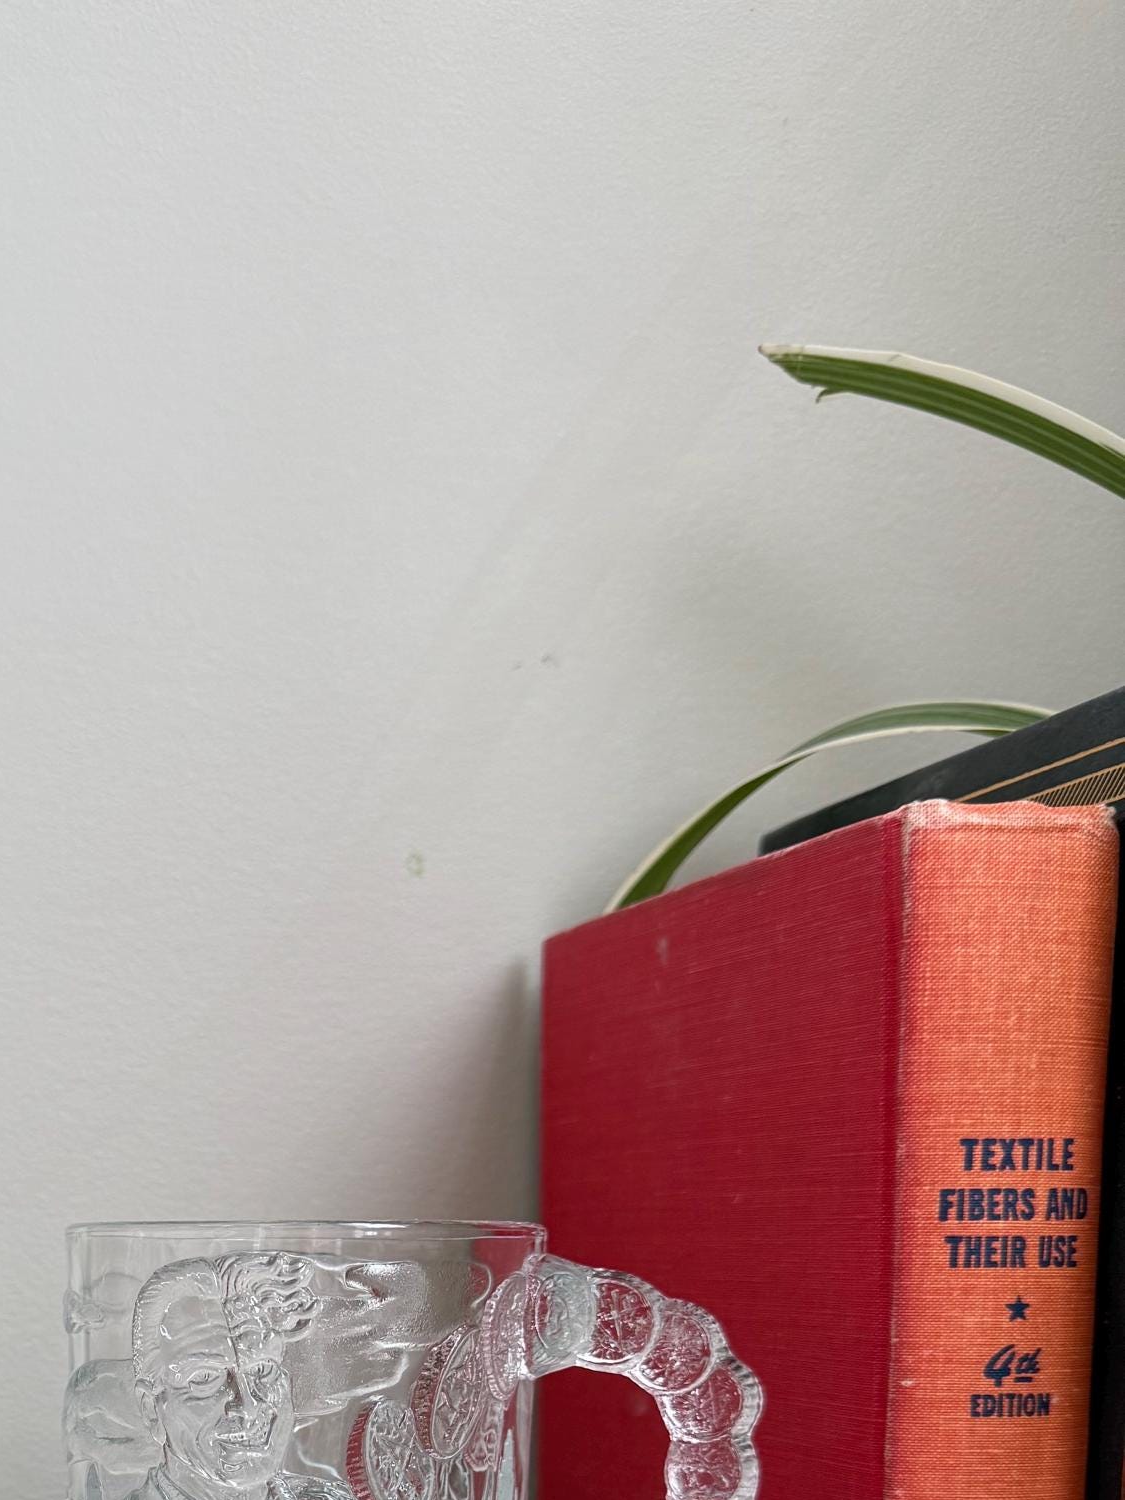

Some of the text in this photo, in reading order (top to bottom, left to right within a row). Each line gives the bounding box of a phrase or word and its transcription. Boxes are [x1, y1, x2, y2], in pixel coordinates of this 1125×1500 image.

[959, 1138, 1075, 1171] TEXTILE
[938, 1187, 1088, 1222] FIBERS AND
[944, 1235, 1078, 1269] THEIR USE
[970, 1393, 1051, 1417] EDITION
